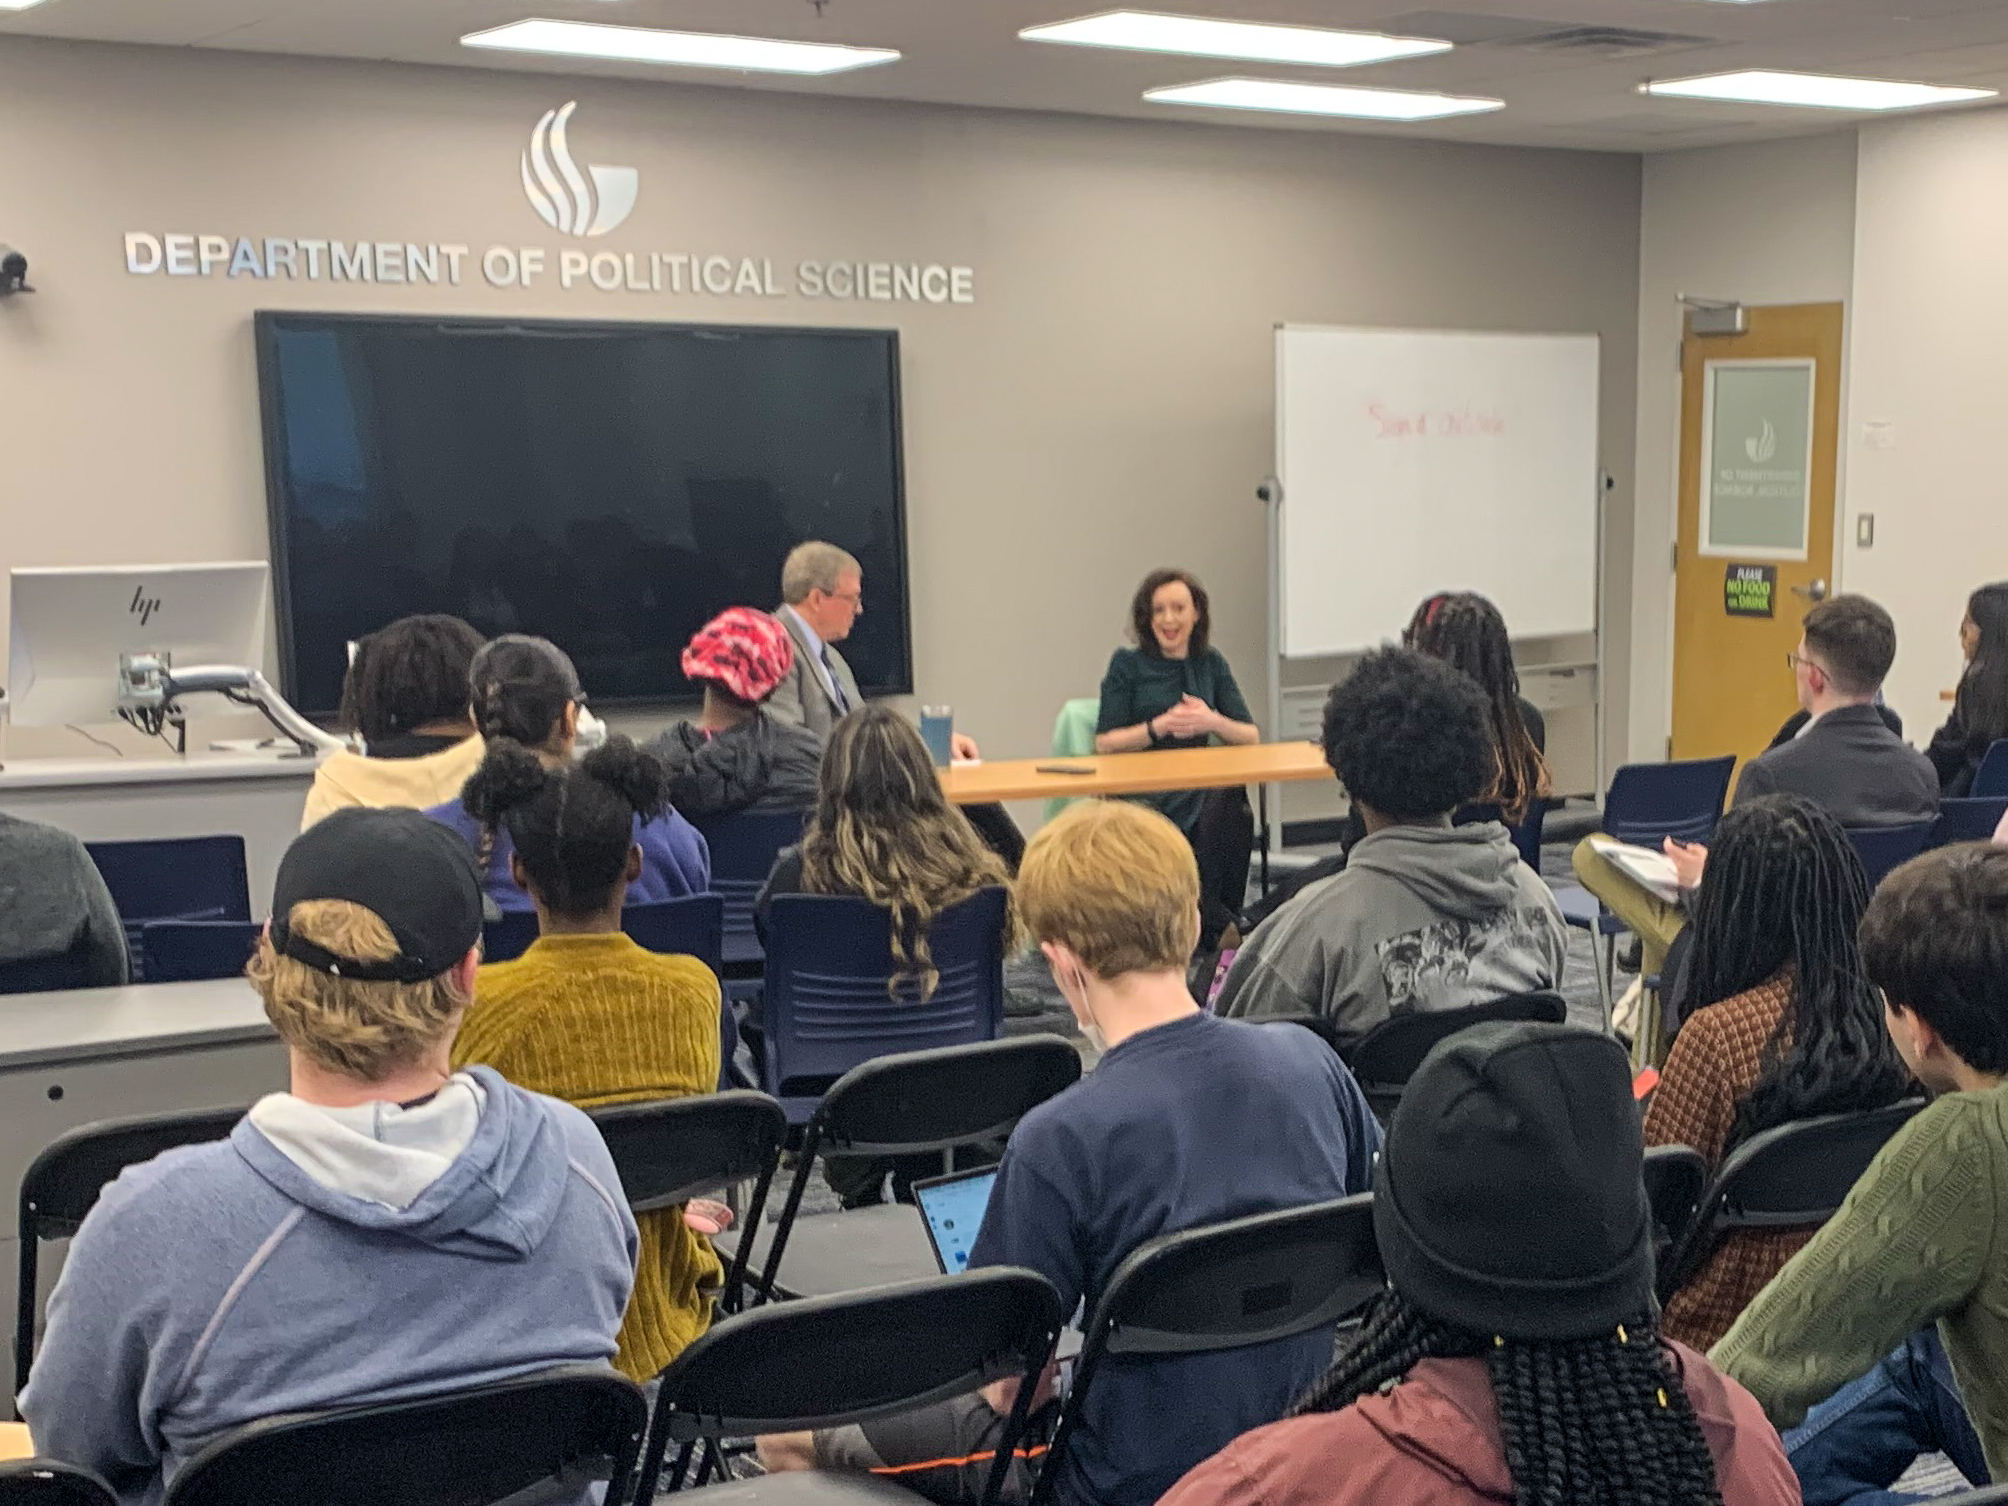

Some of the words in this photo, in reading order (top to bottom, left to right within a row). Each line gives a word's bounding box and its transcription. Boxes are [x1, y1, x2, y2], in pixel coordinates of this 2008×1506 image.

[124, 231, 468, 286] DEPARTMENT
[482, 245, 545, 287] OF
[560, 250, 788, 296] POLITICAL
[799, 260, 975, 304] SCIENCE
[1736, 567, 1763, 581] PLEASE
[1727, 579, 1742, 594] NO
[1743, 580, 1770, 596] FOOD
